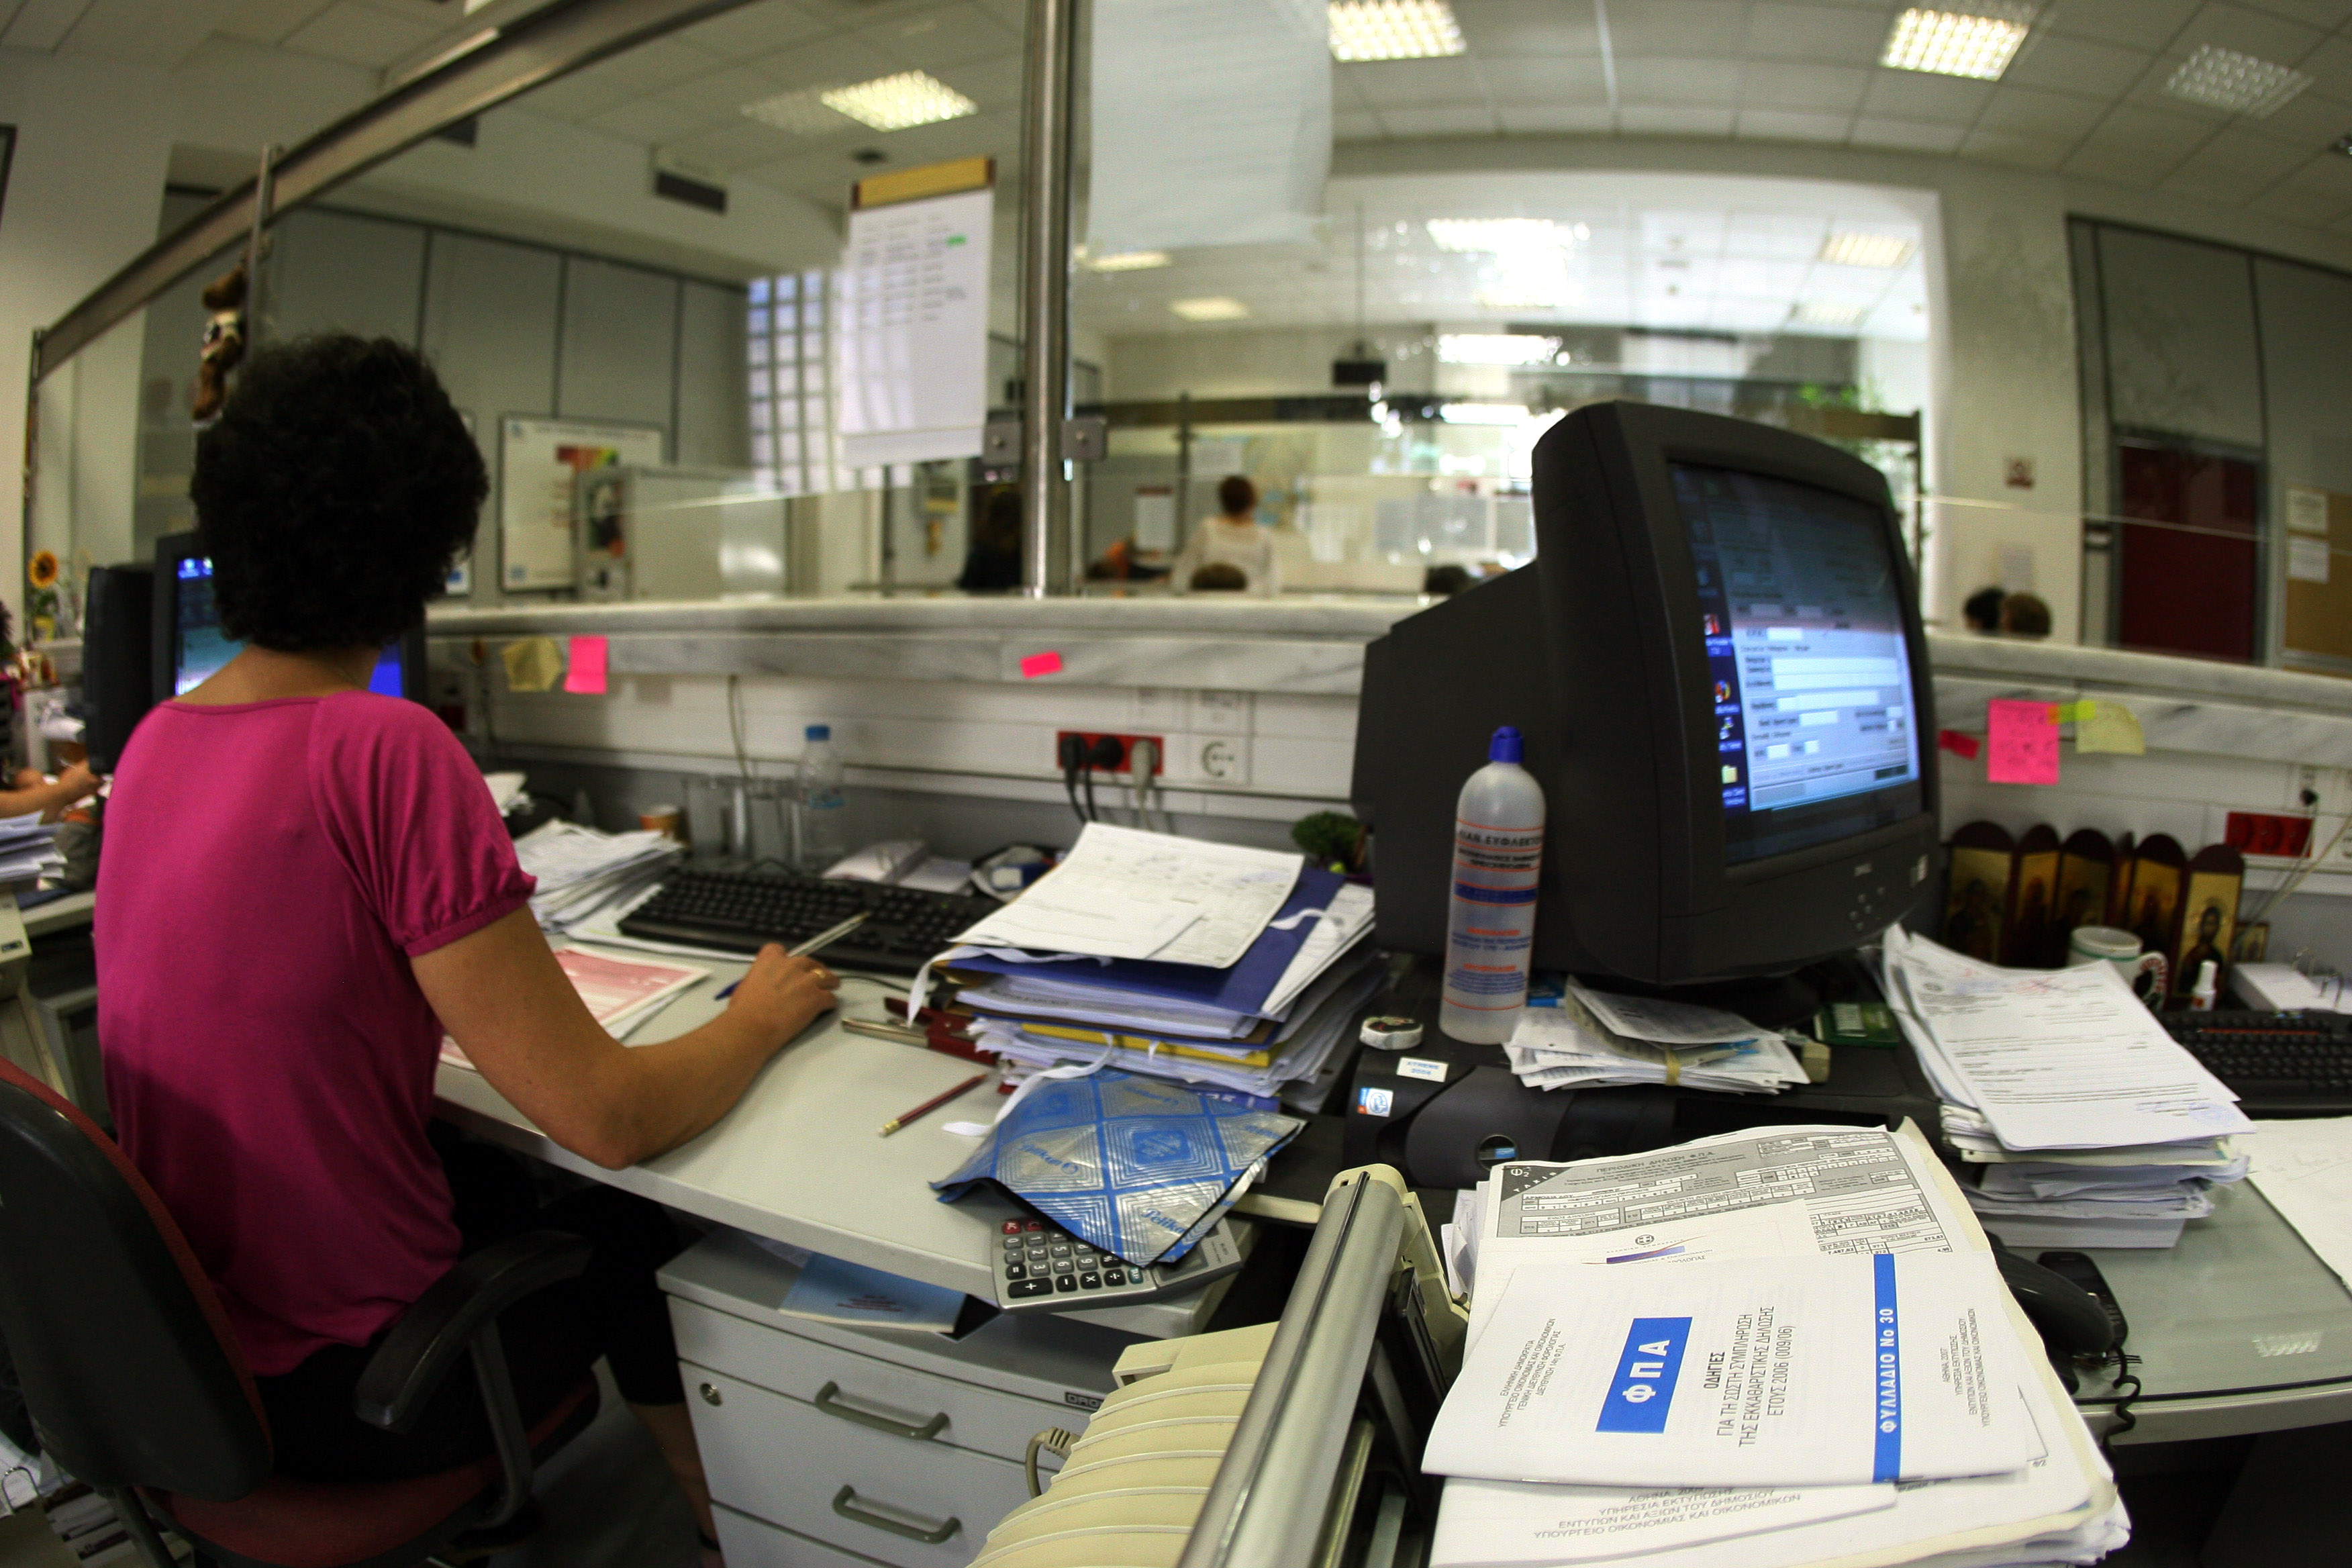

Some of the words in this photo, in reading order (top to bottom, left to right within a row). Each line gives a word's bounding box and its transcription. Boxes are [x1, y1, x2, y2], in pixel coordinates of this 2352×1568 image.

[1596, 1162, 1645, 1173] ΠΕΡΙΟΔΙΚΗ
[1649, 1155, 1685, 1165] ΔΗΛΩΣΗ
[1142, 1208, 1187, 1234] Pelika
[1755, 1306, 1774, 1344] ΔΗΛΩΣΗΣ
[1879, 1309, 1894, 1324] 30
[1967, 1308, 1979, 1344] ΟΙΚΟΝΟΜΙΚΩΝ
[1534, 1318, 1556, 1352] ΟΙΚΟΝΟΜΙΚΩΝ
[1729, 1314, 1753, 1371] ΣΥΜΠΛΗΡΩΣΗ
[1775, 1325, 1796, 1359] (009/06)
[1958, 1318, 1969, 1346] ΔΗΜΟΣΙΟΥ
[1531, 1352, 1540, 1360] ΚΑΙ
[1949, 1334, 1961, 1367] ΕΚΤΥΠΩΣΗΣ
[1962, 1346, 1970, 1358] ΤΟΥ
[1500, 1370, 1520, 1396] ΕΛΛΗΝΙΚΗ
[1514, 1340, 1534, 1371] ΔΗΜΟΚΡΑΤΙΑ
[1514, 1360, 1536, 1392] ΟΙΚΟΝΟΜΙΑΣ
[1517, 1389, 1532, 1410] ΓΕΝΙΚΗ
[1528, 1361, 1545, 1389] ΔΙΕΥΘΥΝΣΗ
[1542, 1330, 1561, 1361] ΦΟΡΟΛΟΓΙΑΣ
[1535, 1367, 1555, 1396] ΔΙΕΥΘΥΝΣΗ
[1622, 1339, 1671, 1404] ΦΠΑ
[1703, 1351, 1725, 1389] ΟΔΗΓΙΕΣ
[1771, 1362, 1789, 1384] 2006
[1963, 1358, 1972, 1375] ΑΞΙΩΝ
[1965, 1376, 1974, 1385] ΚΑΙ
[1973, 1355, 1986, 1391] ΟΙΚΟΝΟΜΙΑΣ
[1723, 1372, 1743, 1401] ΣΩΣΤΗ
[1743, 1345, 1769, 1421] ΕΚΚΑΘΑΡΙΣΤΙΚΗΣ
[1879, 1353, 1898, 1434] ΦΥΛΛΑΔΙΟ
[1953, 1371, 1963, 1396] ΥΠΗΡΕΣΙΑ
[1067, 1393, 1099, 1408] DRO
[1498, 1392, 1519, 1428] ΥΠΟΥΡΓΕΙΟ
[1720, 1404, 1738, 1416] ΤΗ
[1767, 1385, 1786, 1416] ΕΤΟΥΣ
[1966, 1386, 1977, 1415] ΕΝΤΥΠΩΝ
[1979, 1391, 1990, 1428] ΥΠΟΥΡΓΕΙΟ
[1716, 1419, 1735, 1436] ΓΙΑ
[1738, 1424, 1758, 1448] ΤΗΣ
[1559, 1516, 1618, 1529] ΕΝΤΥΠΩΝ
[1620, 1512, 1640, 1522] ΚΑΙ
[1642, 1507, 1680, 1520] ΑΞΙΩΝ
[1681, 1502, 1708, 1512] ΤΟΥ
[1710, 1489, 1775, 1507] ΔΗΜΟΣΙΟΥ
[1598, 1501, 1659, 1516] ΥΠΗΡΕΣΙΑ
[1662, 1487, 1734, 1507] ΕΚΤΥΠΩΣΗΣ
[1628, 1490, 1670, 1504] ΑΘΗΝΑ
[1534, 1525, 1605, 1539] ΥΠΟΥΡΓΕΙΟ
[1608, 1516, 1687, 1534] ΟΙΚΟΝΟΜΙΑΣ
[1689, 1510, 1710, 1520] ΚΑΙ
[1712, 1495, 1801, 1516] ΟΙΚΟΝΟΜΙΚΩΝ
